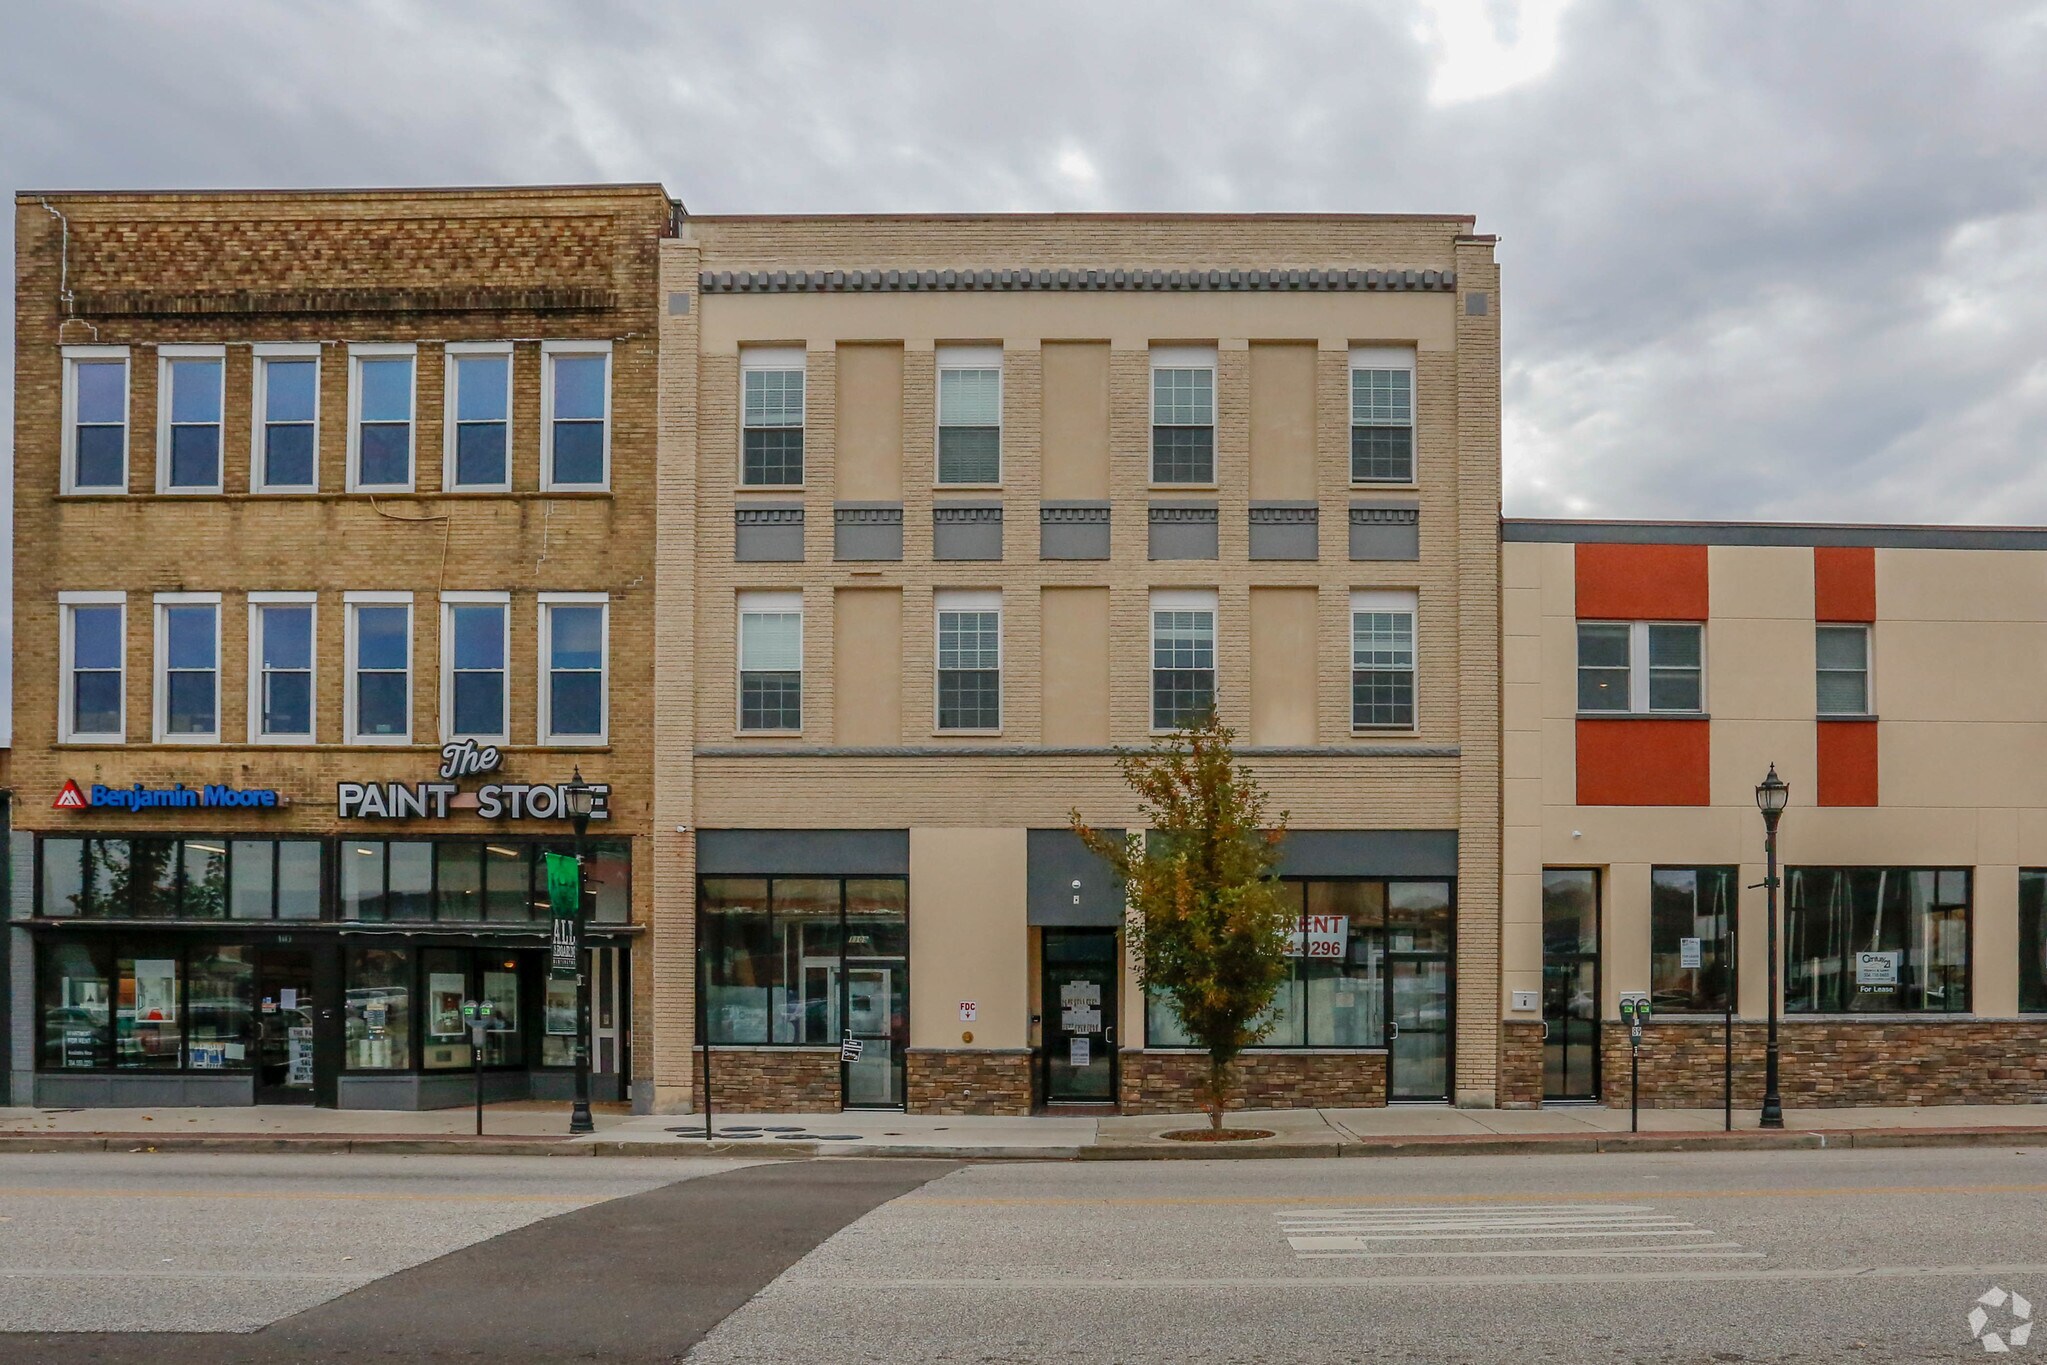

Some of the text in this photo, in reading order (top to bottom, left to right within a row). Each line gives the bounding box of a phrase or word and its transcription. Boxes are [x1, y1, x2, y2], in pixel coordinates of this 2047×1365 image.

[440, 740, 501, 778] The
[91, 783, 278, 812] Benjamin Moore
[338, 784, 609, 819] PAINT STOE
[552, 919, 576, 944] ALL
[1289, 915, 1344, 934] ENT
[1860, 985, 1894, 993] For Lease
[960, 1002, 976, 1011] FDC
